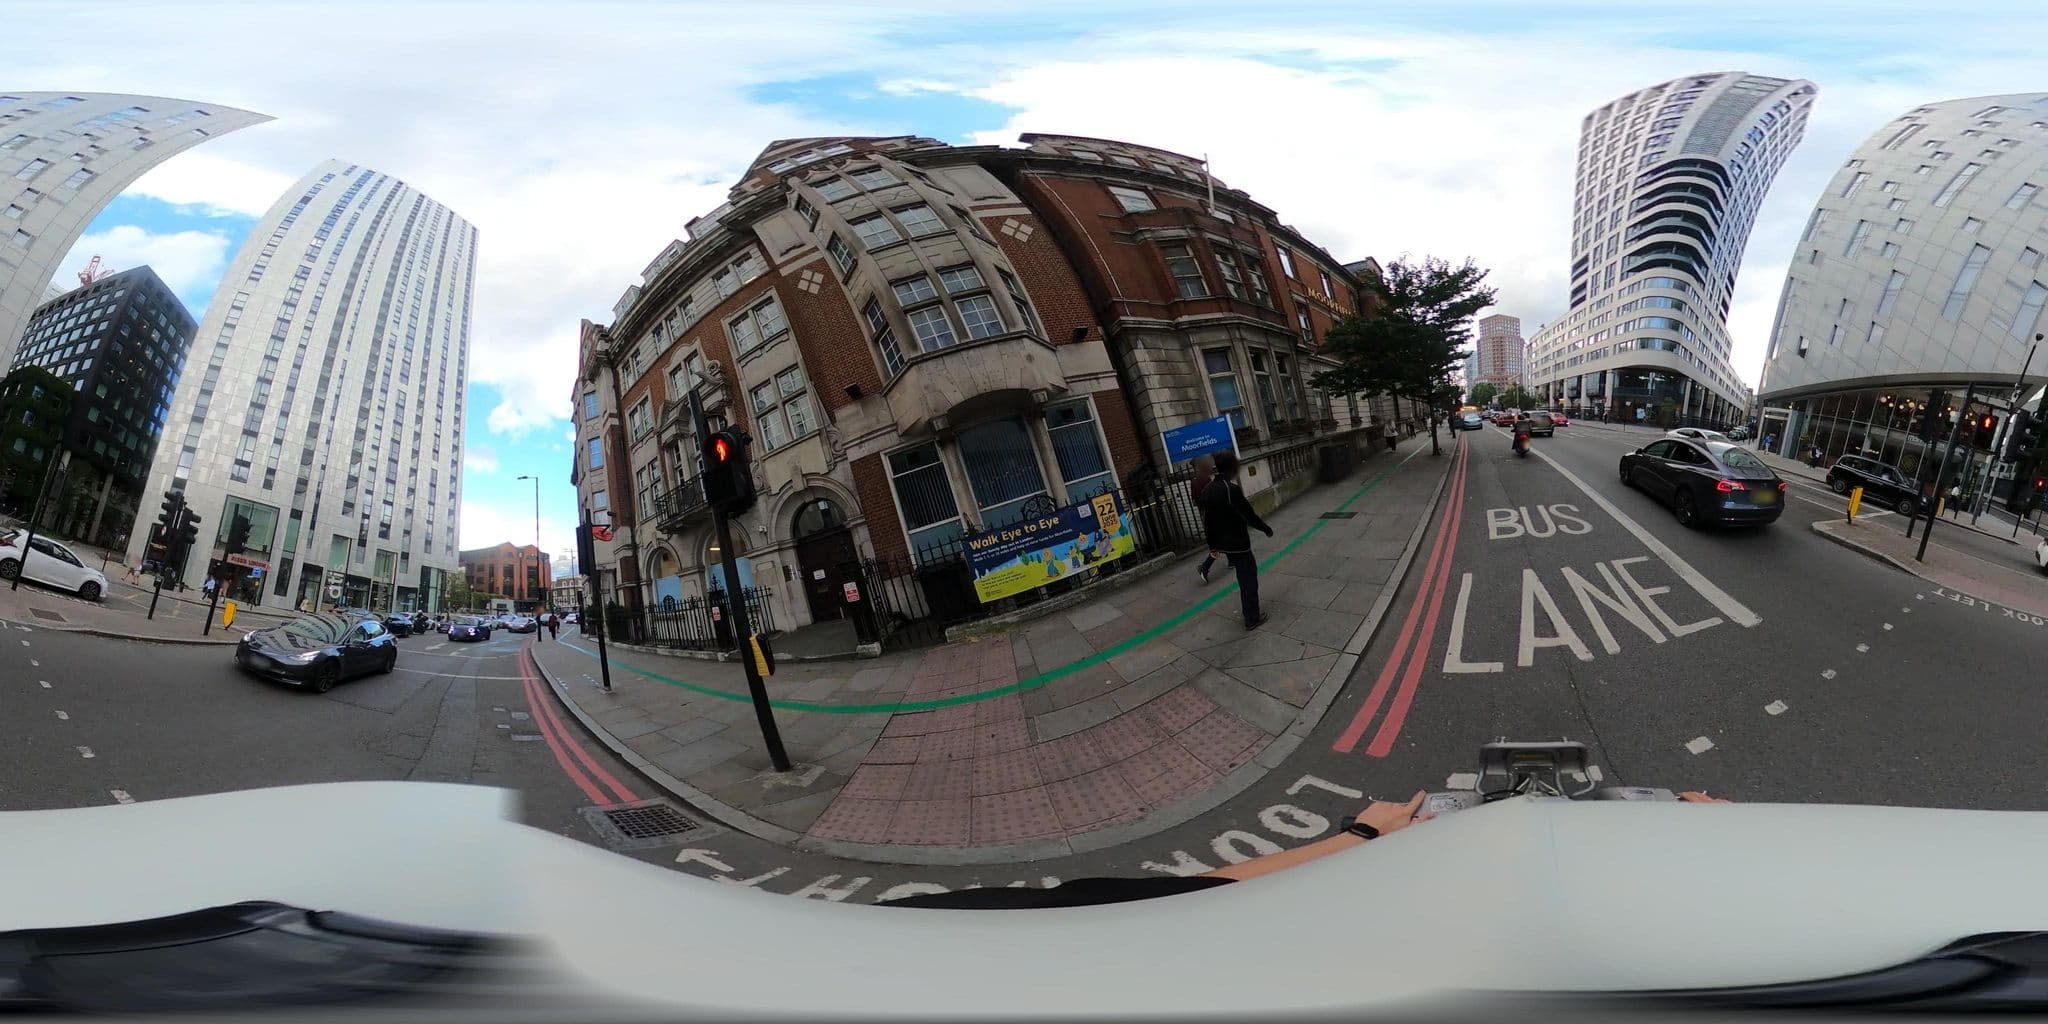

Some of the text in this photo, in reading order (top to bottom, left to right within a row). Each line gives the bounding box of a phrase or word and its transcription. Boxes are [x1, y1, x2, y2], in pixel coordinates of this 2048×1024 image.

[1181, 438, 1218, 452] Moorfields
[1098, 503, 1114, 516] 22
[1487, 504, 1593, 540] BUS
[969, 534, 999, 550] Walk
[1001, 529, 1022, 541] Eye
[1024, 524, 1037, 533] to
[1038, 516, 1060, 529] Eye
[1443, 556, 1724, 673] LANE
[1931, 588, 2048, 626] OOK LEFT
